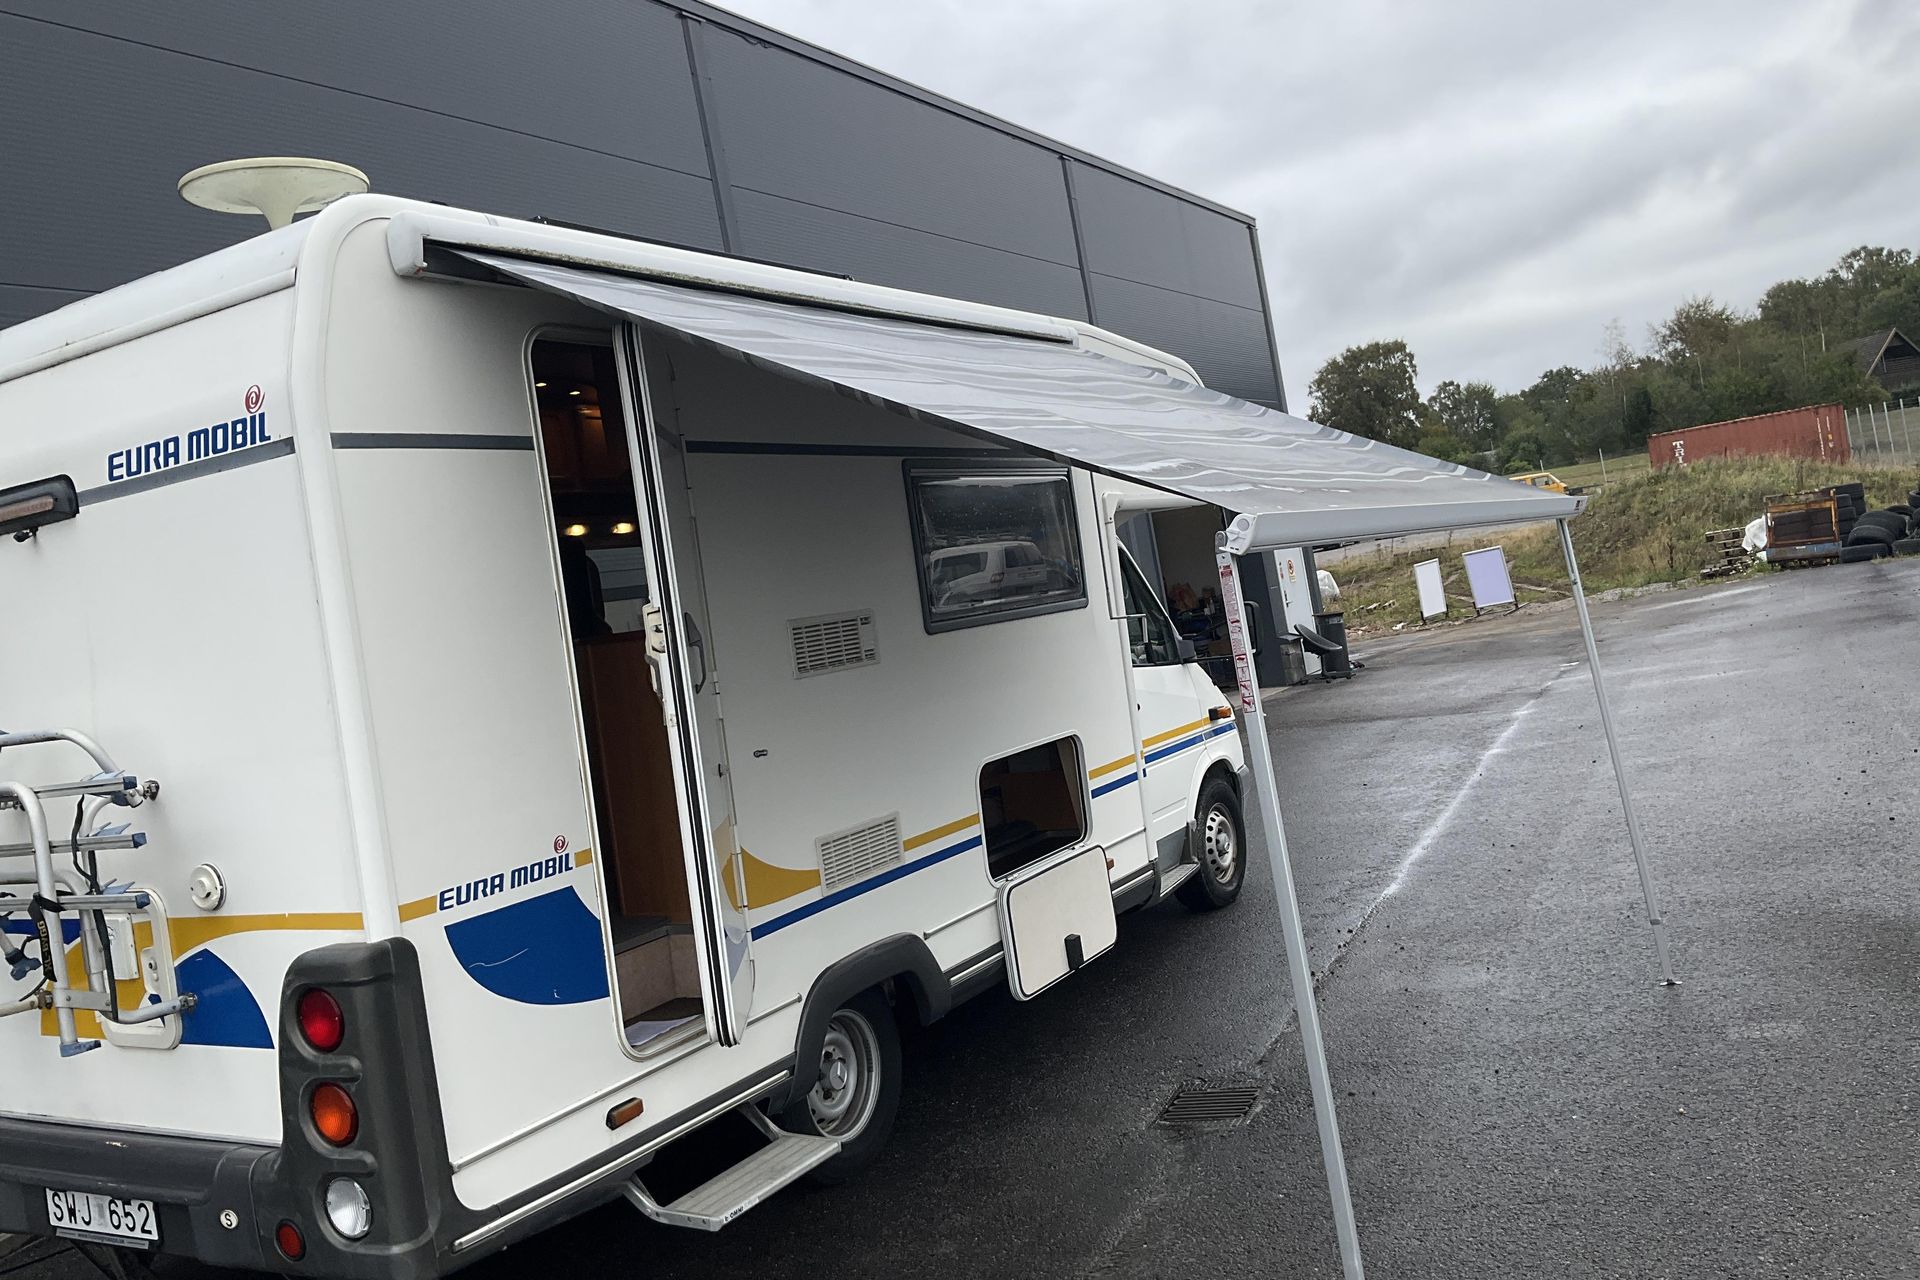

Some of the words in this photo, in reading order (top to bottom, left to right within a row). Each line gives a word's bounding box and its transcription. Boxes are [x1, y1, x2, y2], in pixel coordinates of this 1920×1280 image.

[107, 435, 181, 482] EURA
[187, 411, 271, 461] MOBIL
[438, 872, 504, 911] EURA
[510, 852, 573, 890] MOBIL
[53, 1190, 92, 1226] SWJ
[108, 1198, 152, 1235] 652
[225, 1213, 233, 1227] S
